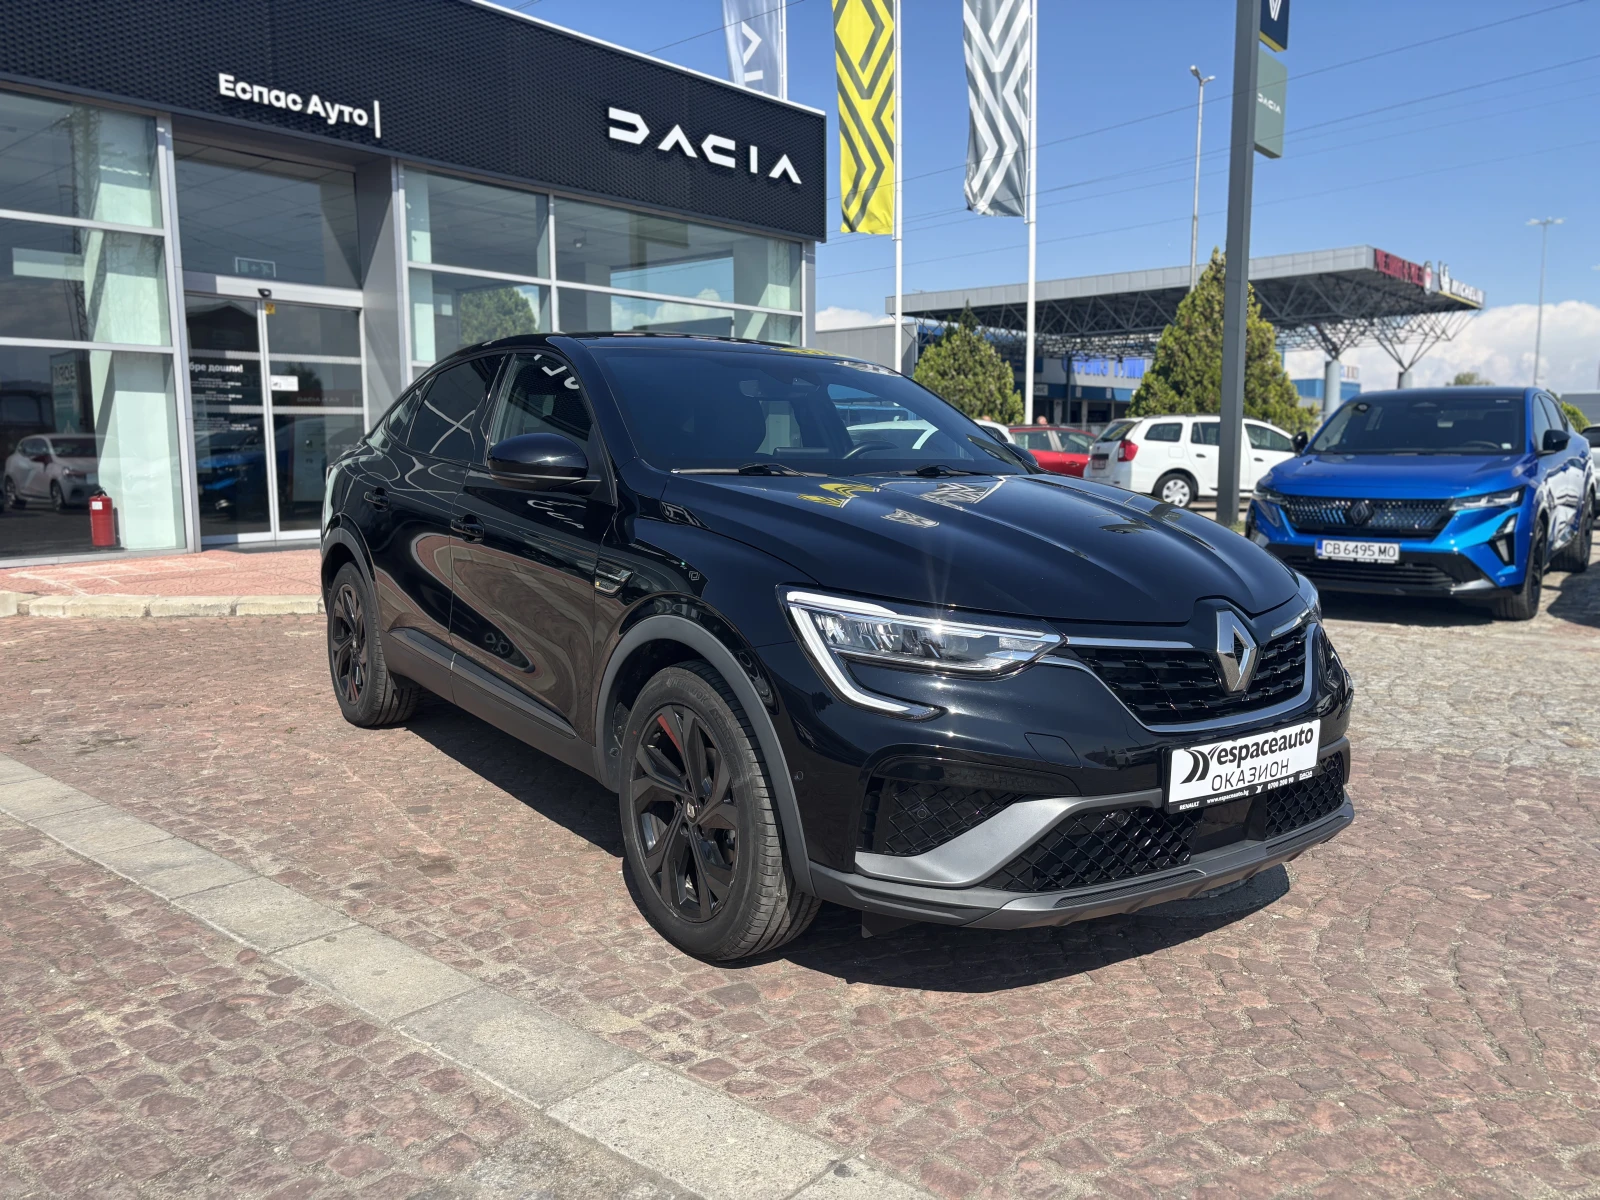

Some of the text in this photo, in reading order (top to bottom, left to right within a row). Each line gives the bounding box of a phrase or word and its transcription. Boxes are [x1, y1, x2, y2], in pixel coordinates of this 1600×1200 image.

[218, 73, 369, 126] Еспас Ауто
[1257, 92, 1282, 115] DACIA
[607, 106, 802, 185] DACIA
[189, 361, 243, 373] бре дошли!
[1325, 542, 1396, 558] CB 6495 MO
[1216, 726, 1314, 768] espaceauto
[1179, 801, 1200, 810] RENAULT
[1206, 789, 1250, 803] www.espaceauto.bg
[1299, 770, 1313, 780] DACIA
[1211, 758, 1290, 791] ОКАЗИОН
